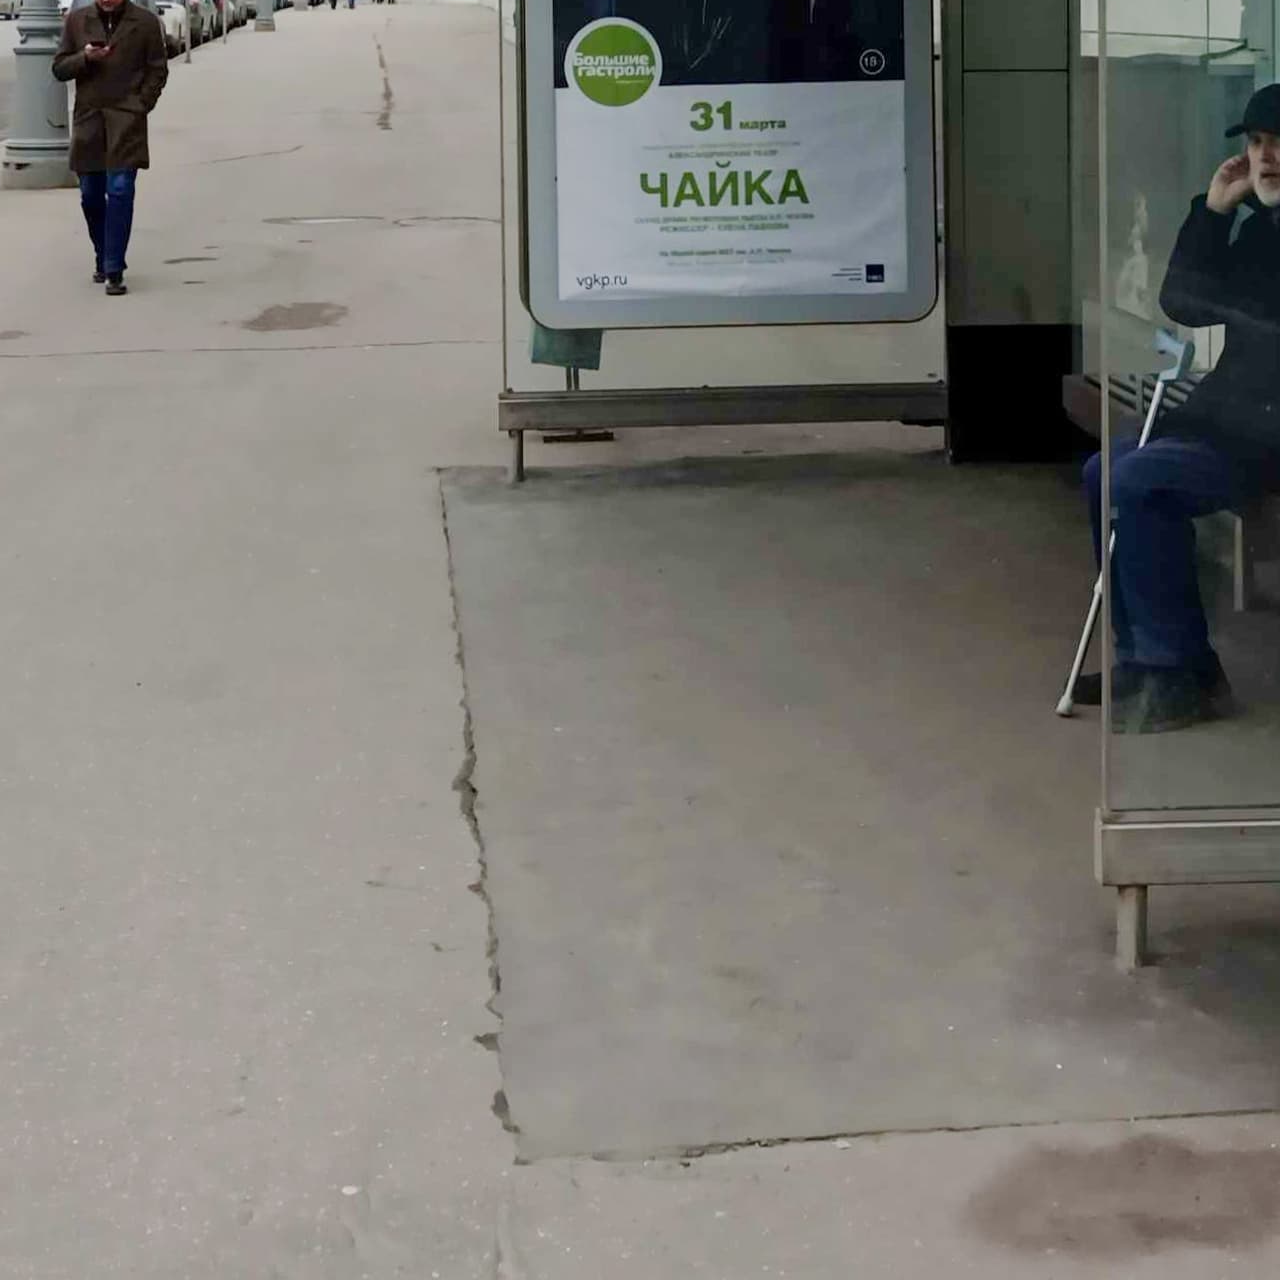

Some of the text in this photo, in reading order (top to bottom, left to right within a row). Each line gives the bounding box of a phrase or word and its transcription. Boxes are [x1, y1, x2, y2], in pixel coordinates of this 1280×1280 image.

[574, 52, 650, 66] Большие
[578, 65, 656, 79] гастроли
[690, 101, 787, 131] 31 марта
[640, 160, 810, 208] ЧАЙКА
[576, 274, 627, 290] vgkp.ru
